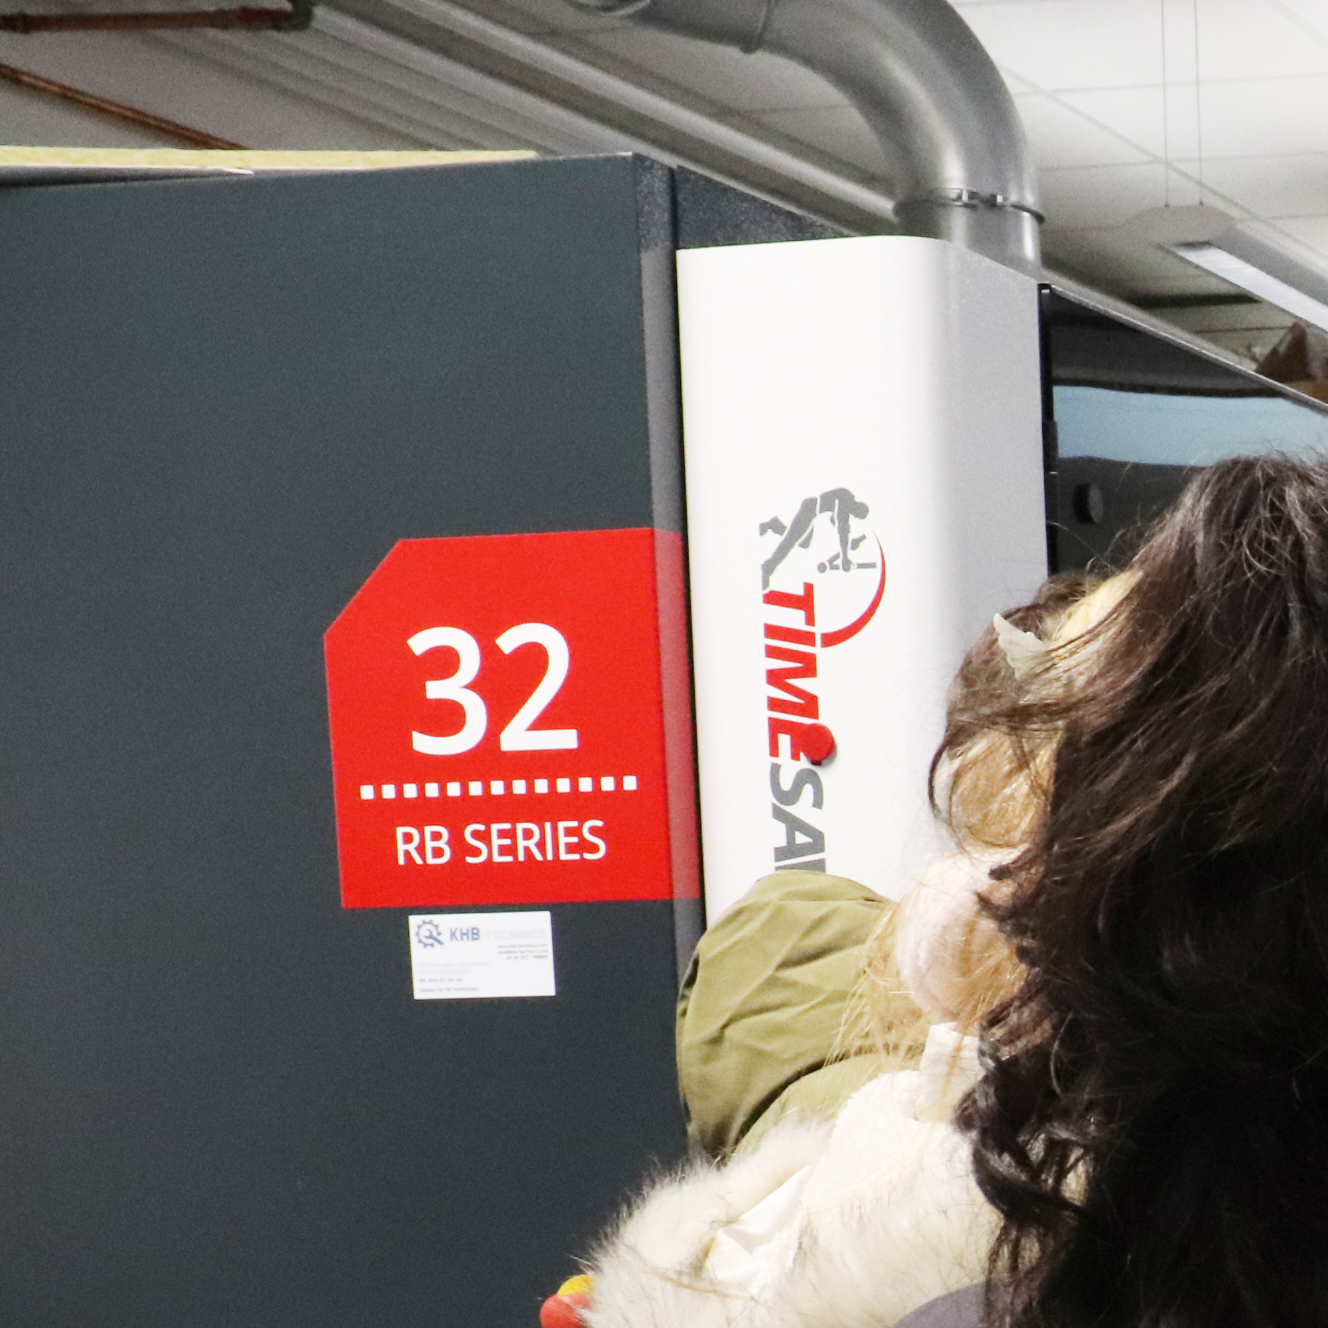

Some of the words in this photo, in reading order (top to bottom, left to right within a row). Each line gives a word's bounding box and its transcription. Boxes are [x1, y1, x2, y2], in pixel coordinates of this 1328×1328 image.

[407, 622, 579, 756] 32
[396, 825, 451, 866] RB
[464, 819, 607, 864] SERIES
